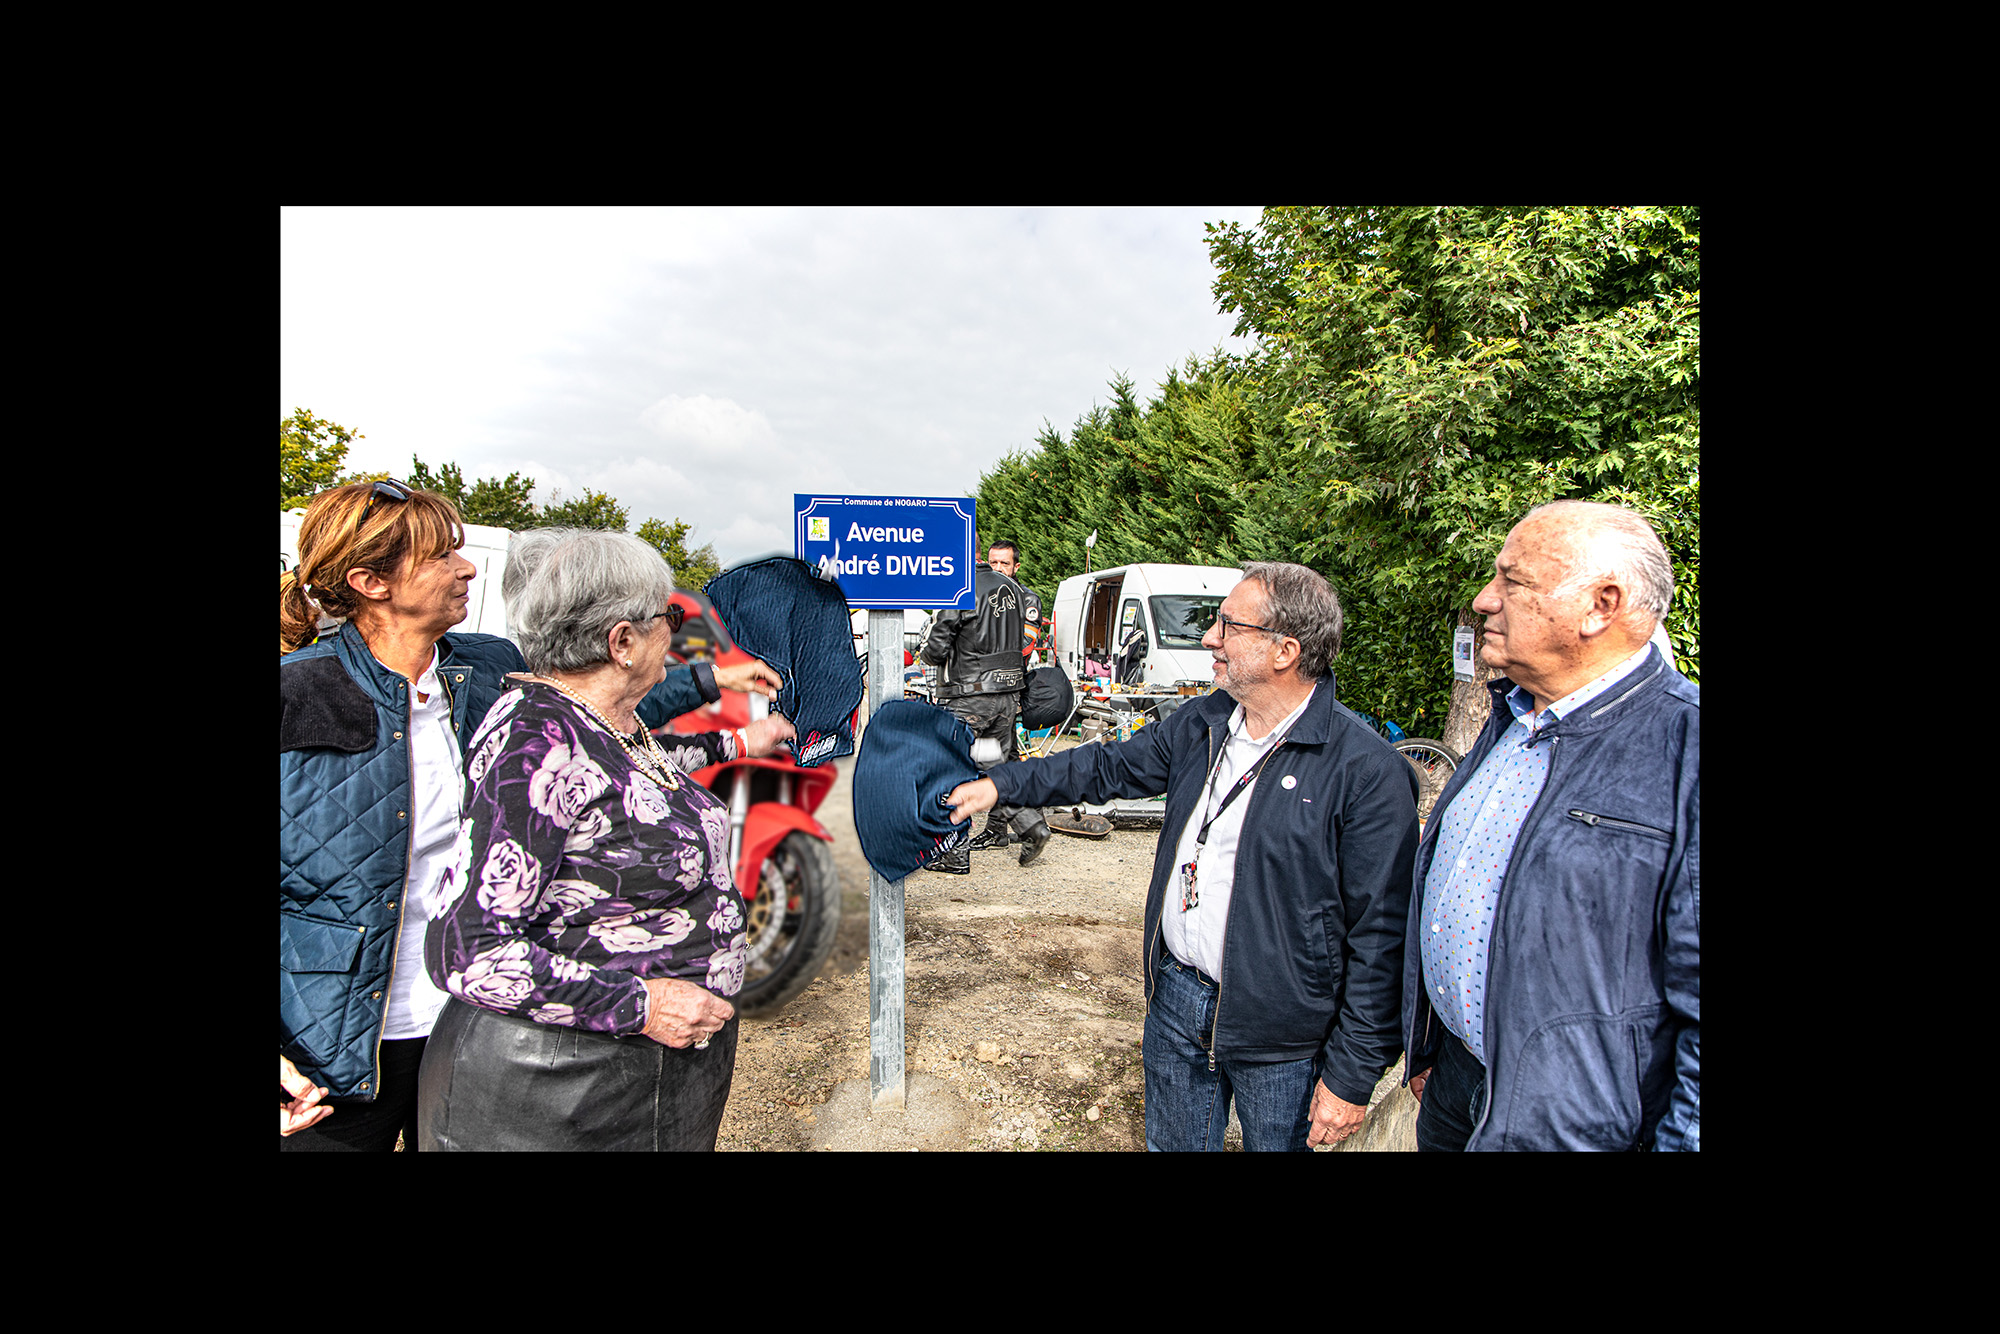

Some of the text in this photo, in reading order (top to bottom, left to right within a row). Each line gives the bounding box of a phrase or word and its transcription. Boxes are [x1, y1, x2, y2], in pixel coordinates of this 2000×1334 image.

[844, 497, 882, 506] Commune
[884, 498, 893, 506] de
[846, 522, 924, 542] Avenue
[817, 554, 954, 575] André DIVIES
